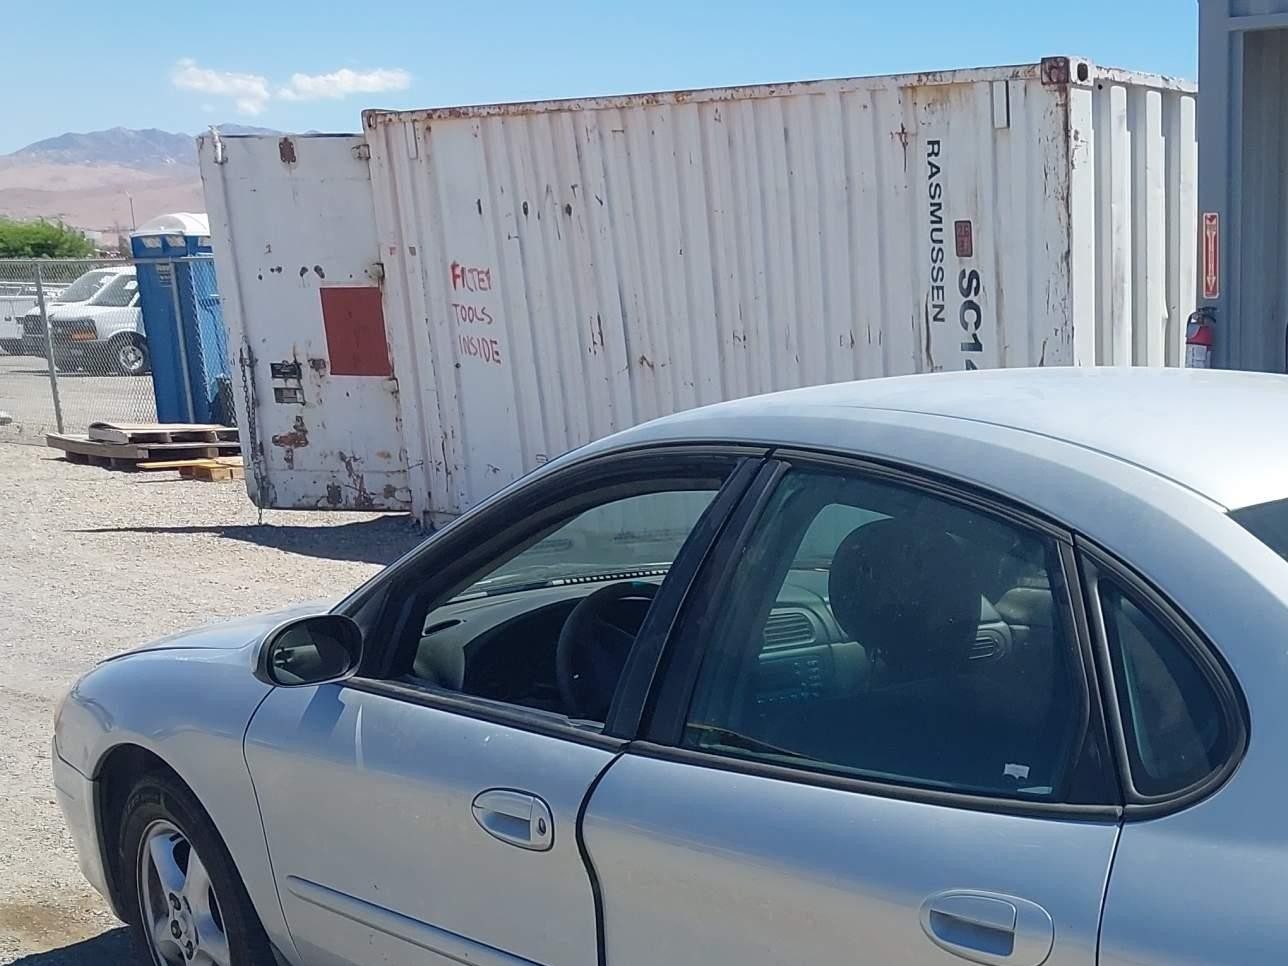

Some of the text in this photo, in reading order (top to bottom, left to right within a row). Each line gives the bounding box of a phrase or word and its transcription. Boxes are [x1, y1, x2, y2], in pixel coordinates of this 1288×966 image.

[926, 140, 946, 323] RASMUSSEN
[451, 303, 494, 326] TOOLS
[458, 333, 502, 365] INSIDE
